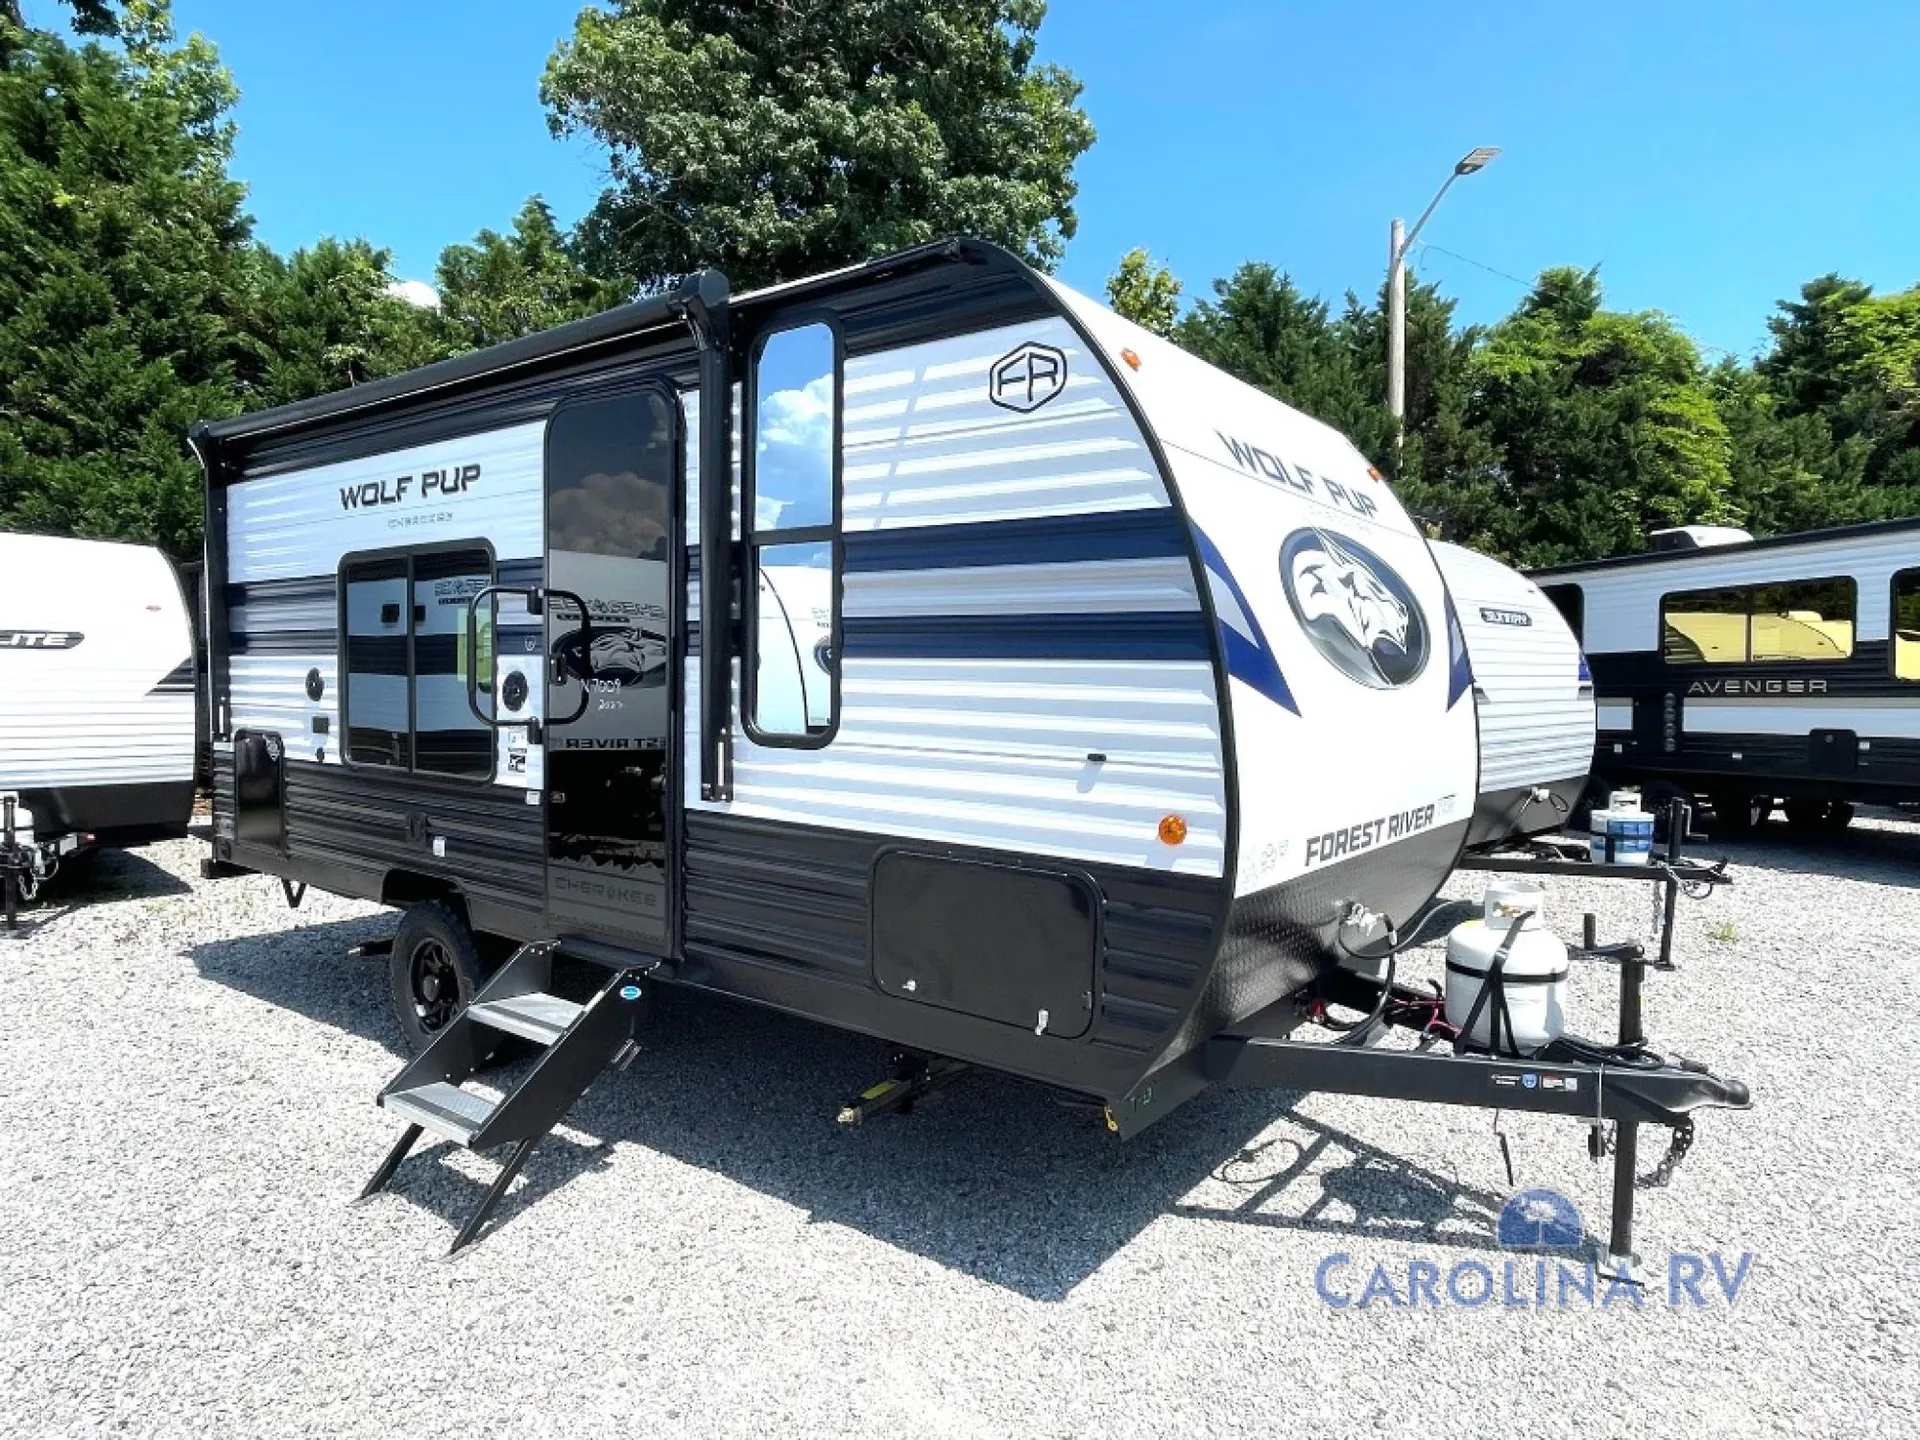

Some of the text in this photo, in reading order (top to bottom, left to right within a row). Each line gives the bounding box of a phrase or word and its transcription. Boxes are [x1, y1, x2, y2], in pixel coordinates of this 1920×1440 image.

[339, 463, 481, 511] WOLF PUP
[1213, 427, 1379, 520] WOLF PUP
[1687, 679, 1828, 694] AVENGER
[1304, 816, 1386, 867] FOREST
[1386, 803, 1435, 840] RIVER
